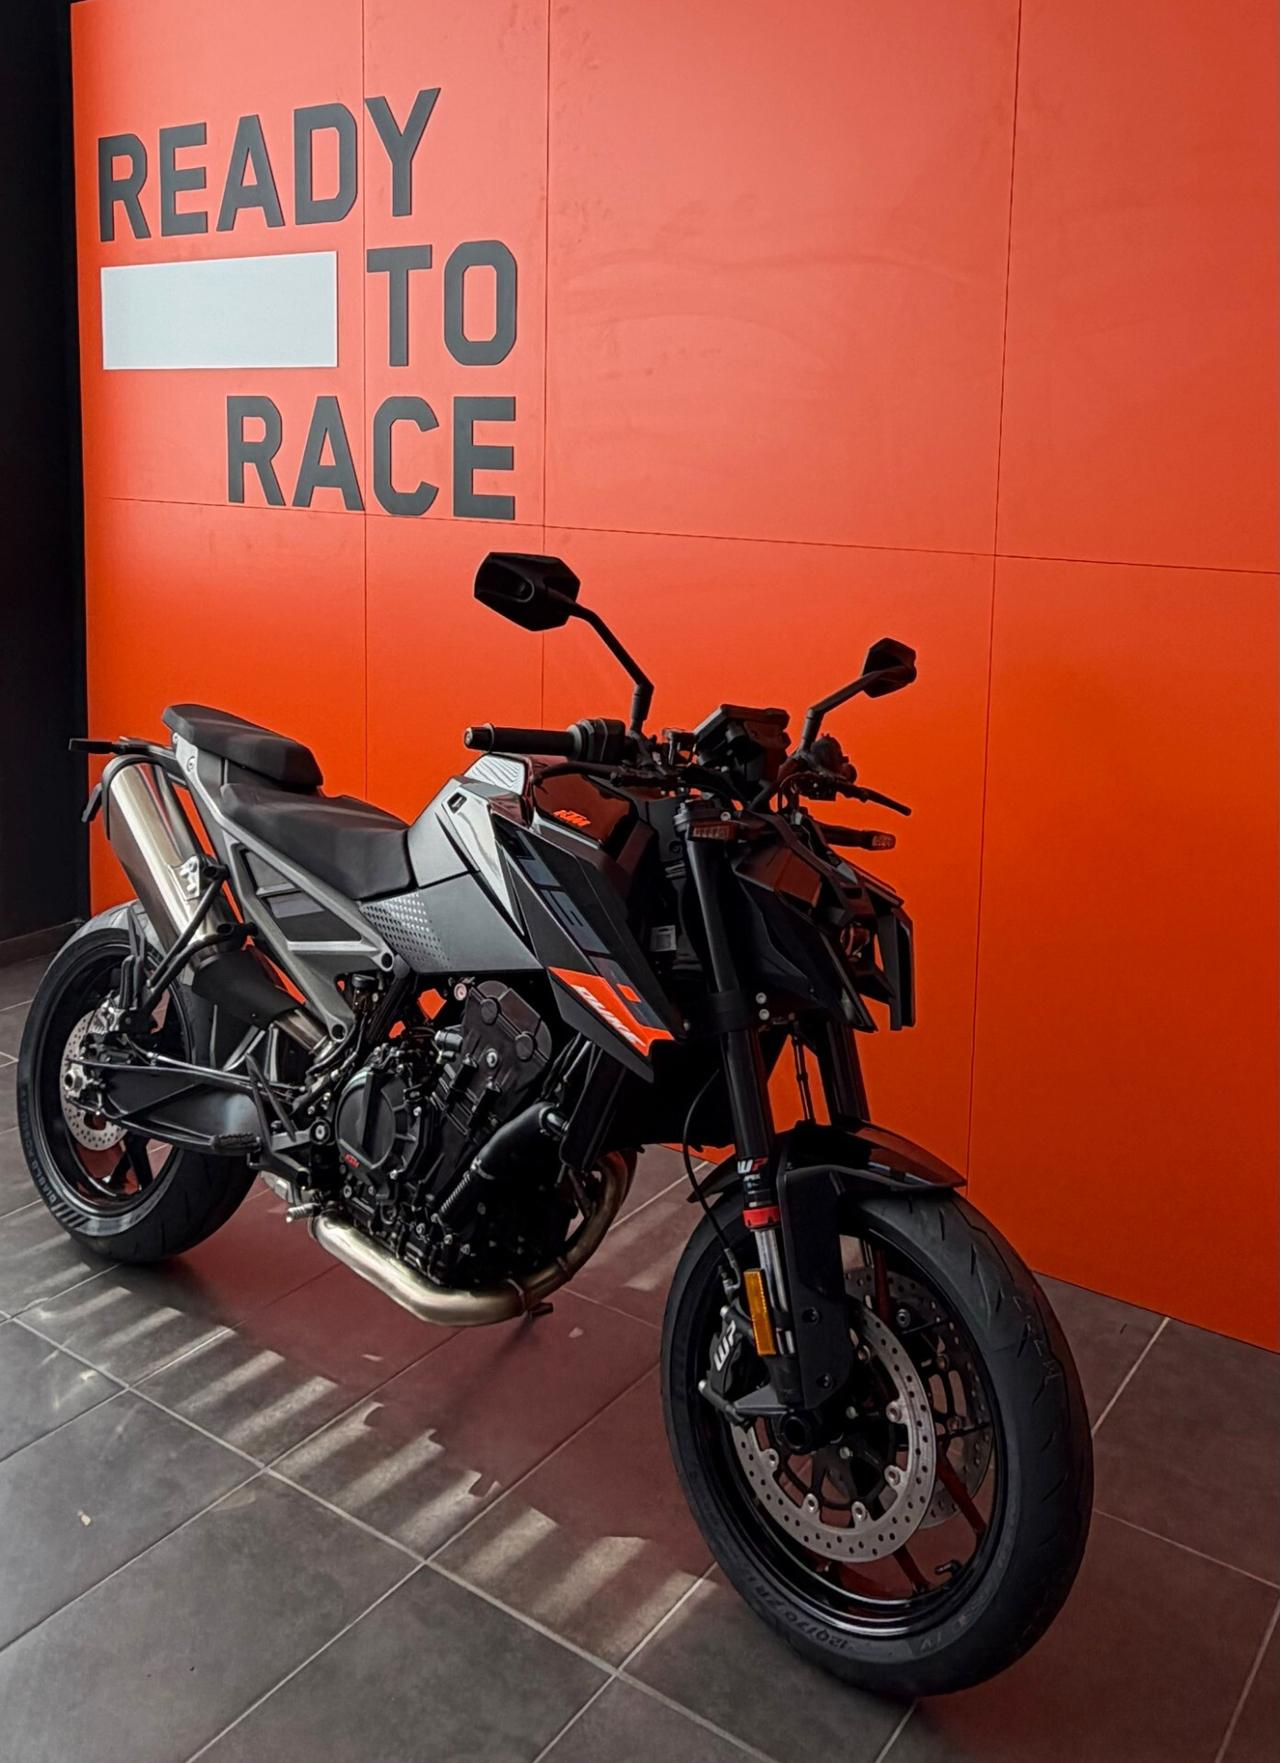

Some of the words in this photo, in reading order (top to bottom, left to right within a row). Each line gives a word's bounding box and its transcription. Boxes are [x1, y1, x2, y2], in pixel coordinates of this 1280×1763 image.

[98, 87, 441, 242] READY
[366, 239, 517, 367] TO
[227, 395, 516, 520] RACE
[552, 809, 592, 828] KTM
